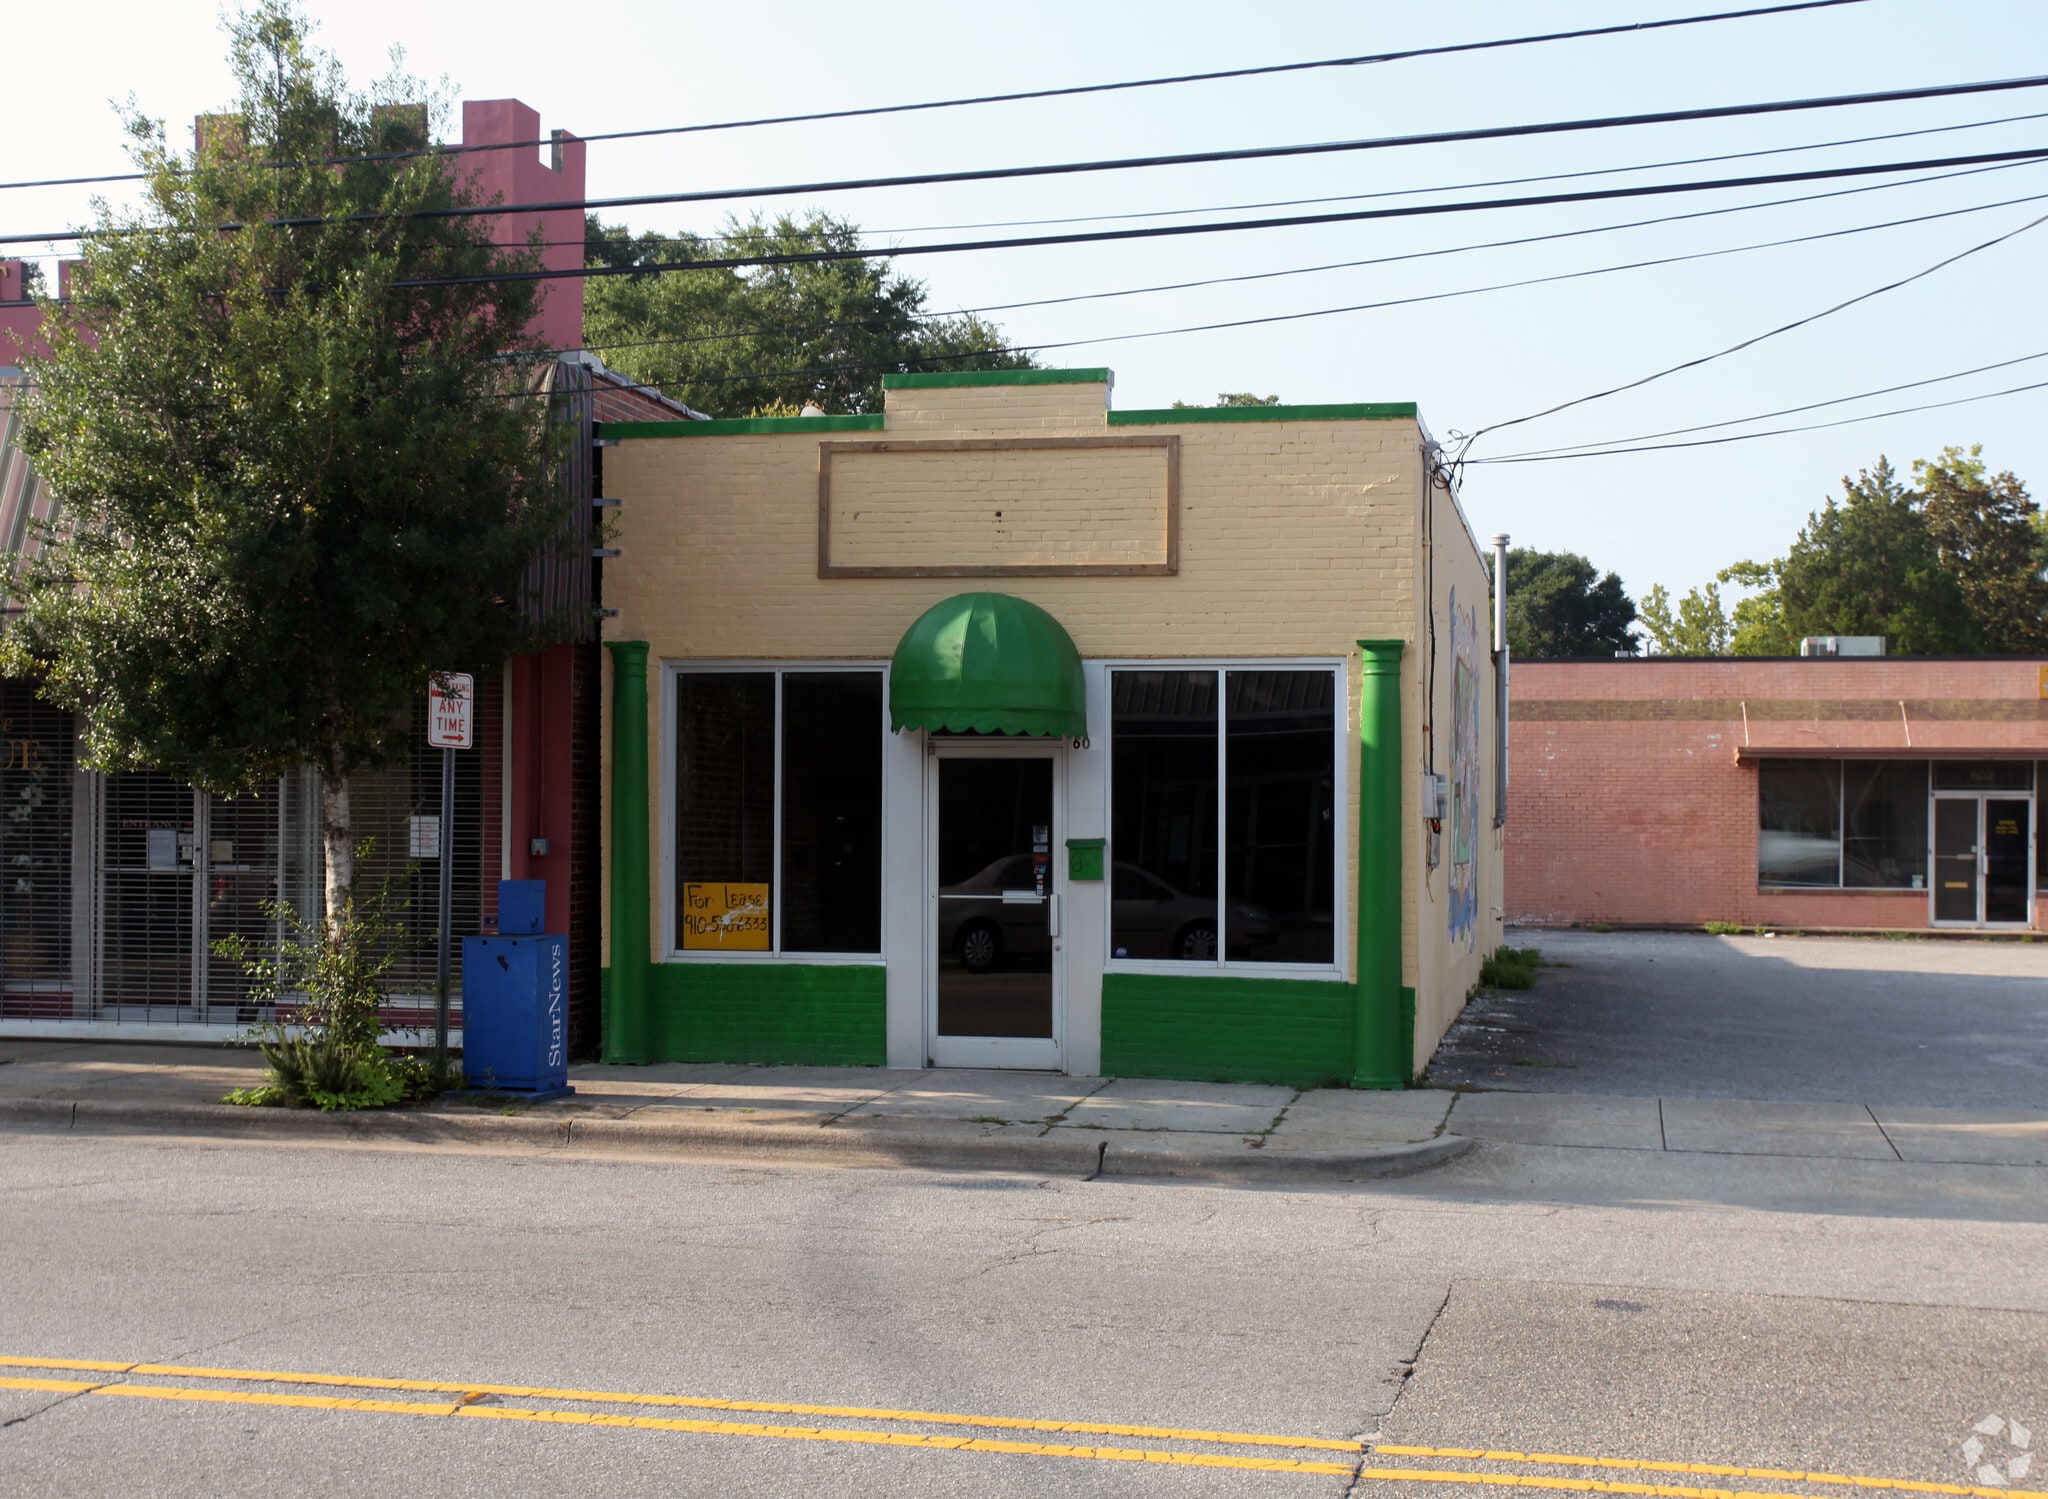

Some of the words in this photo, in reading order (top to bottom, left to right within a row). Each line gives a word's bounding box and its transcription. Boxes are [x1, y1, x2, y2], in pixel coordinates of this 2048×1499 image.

[439, 699, 463, 714] ANY
[436, 716, 465, 733] TIME
[122, 819, 180, 829] ENTRANC
[687, 884, 714, 910] For
[724, 885, 763, 909] Lease
[548, 943, 561, 1067] StarNews
